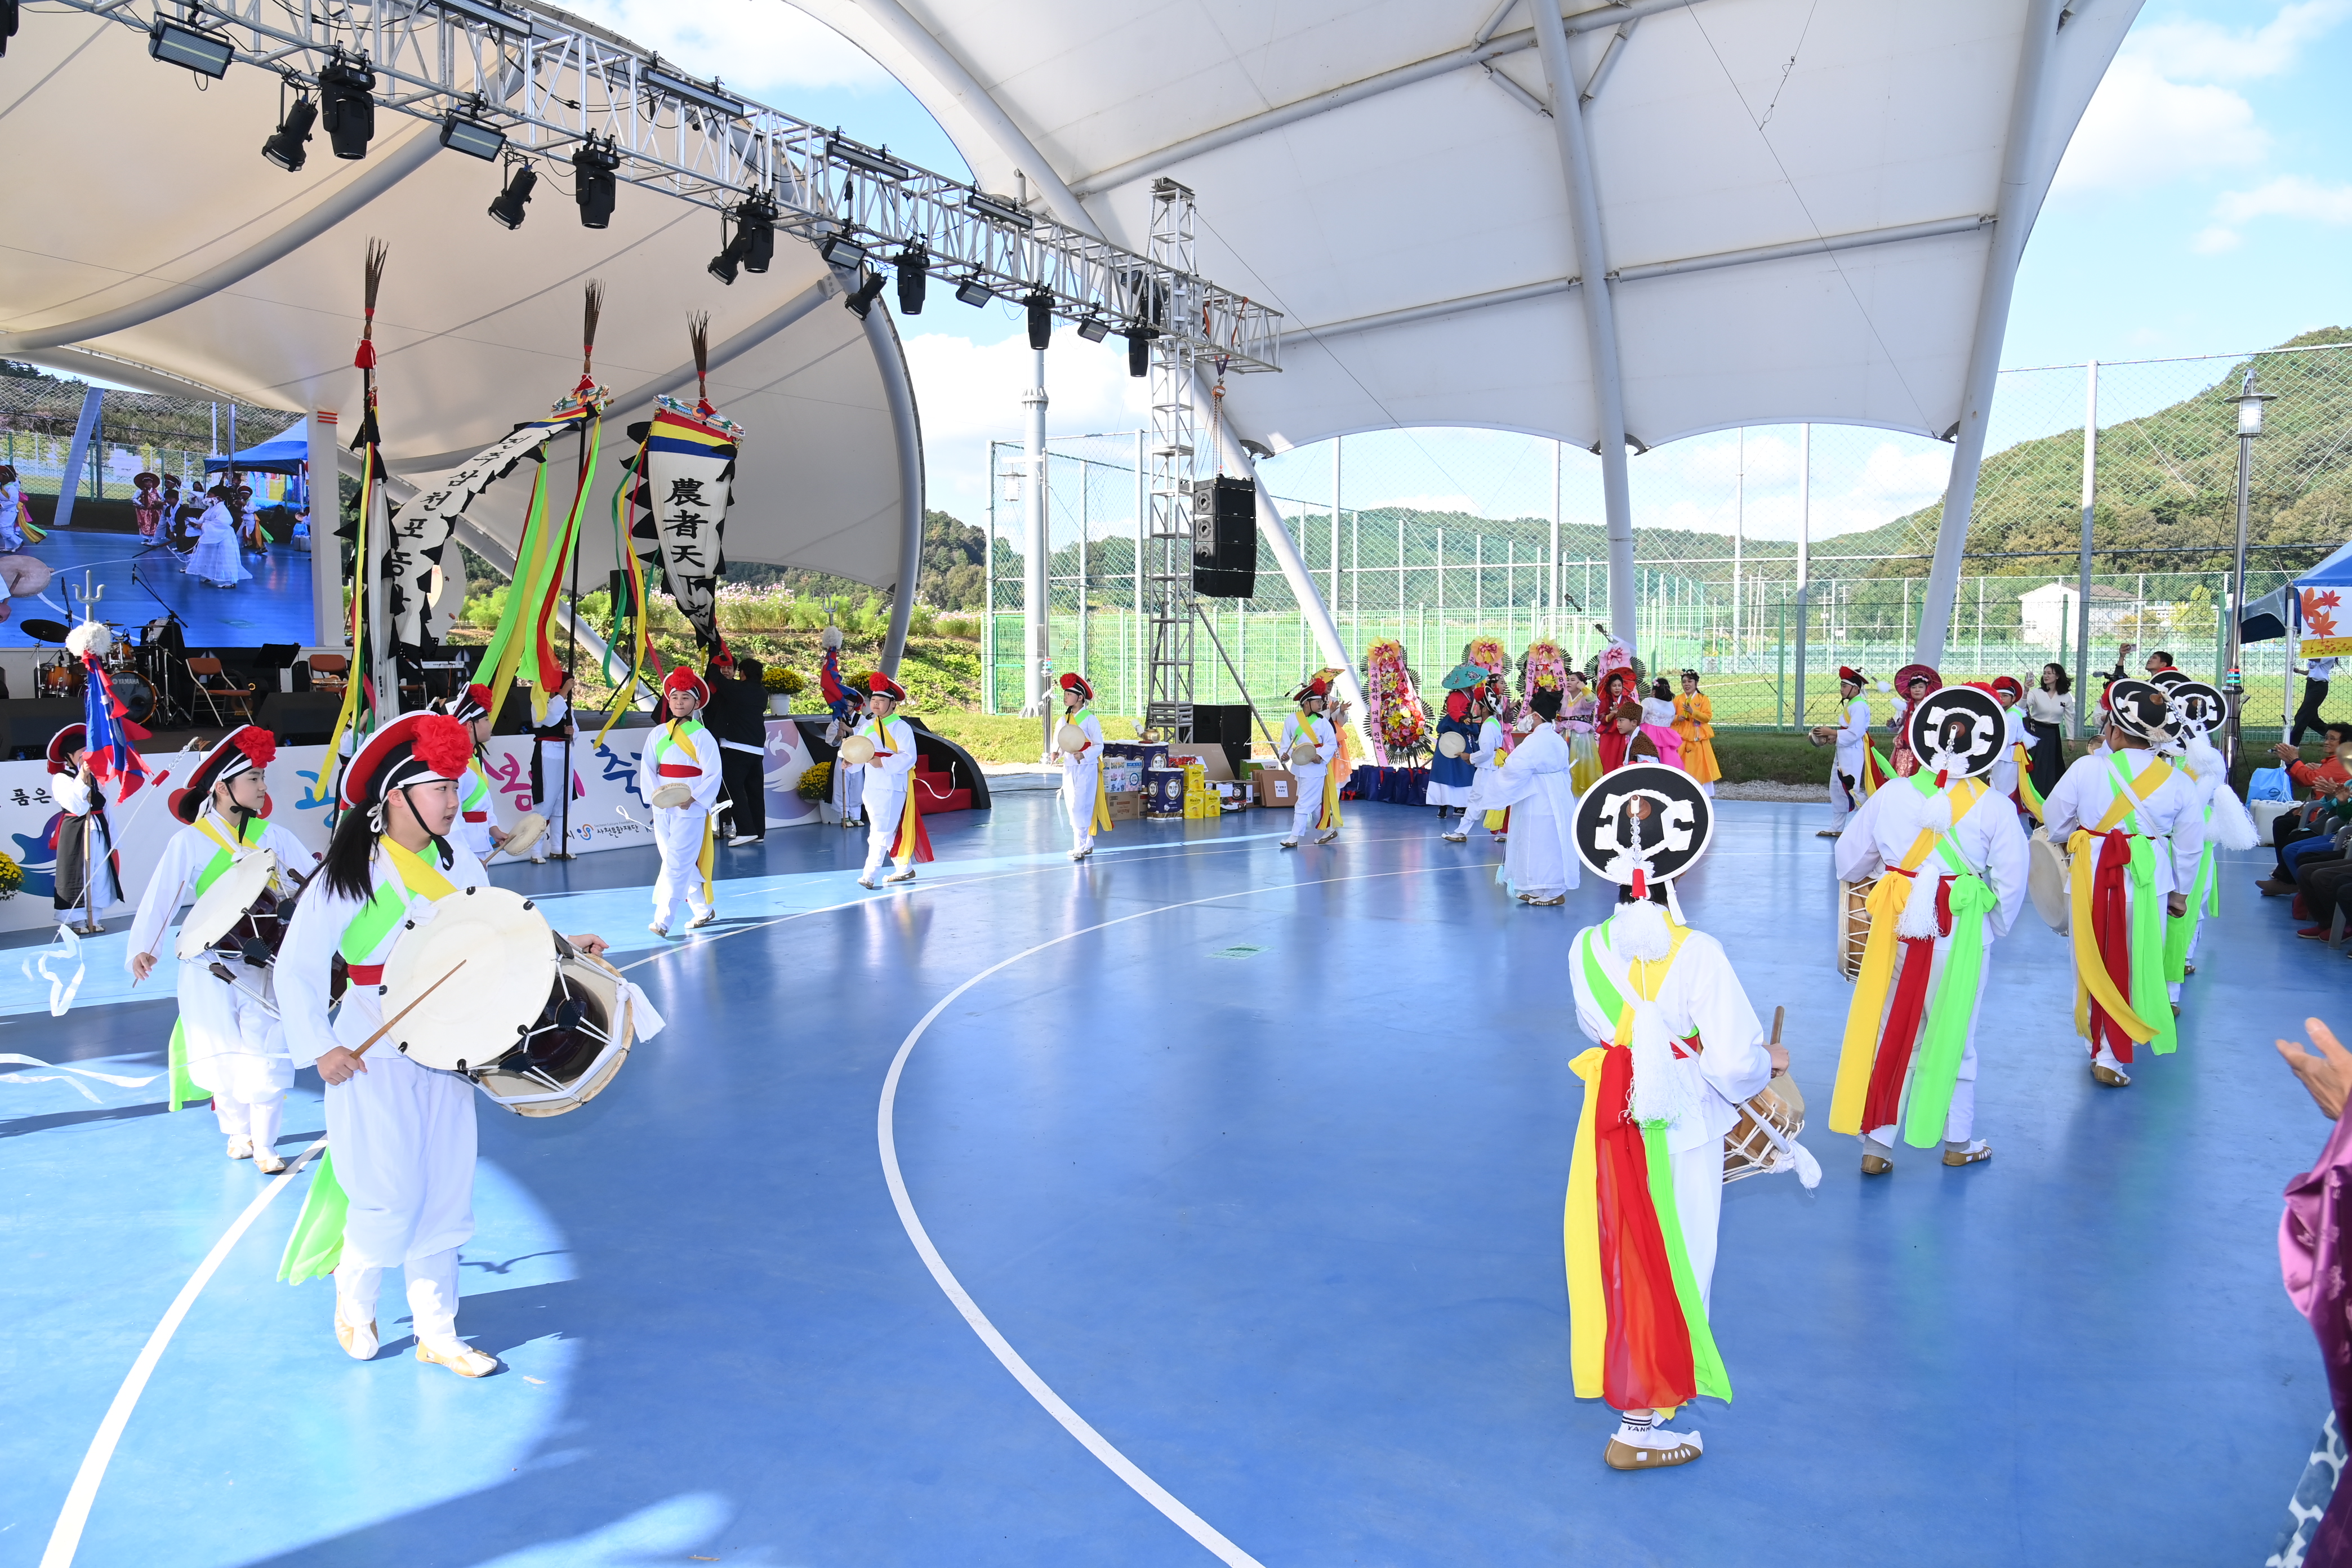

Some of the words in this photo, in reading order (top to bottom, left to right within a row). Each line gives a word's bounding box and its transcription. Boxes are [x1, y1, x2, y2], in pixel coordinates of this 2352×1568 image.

[392, 435, 532, 602] 진주삼천포농
[1372, 710, 1380, 724] 대표
[10, 787, 52, 806] 품은
[597, 825, 639, 838] 사천문화재단
